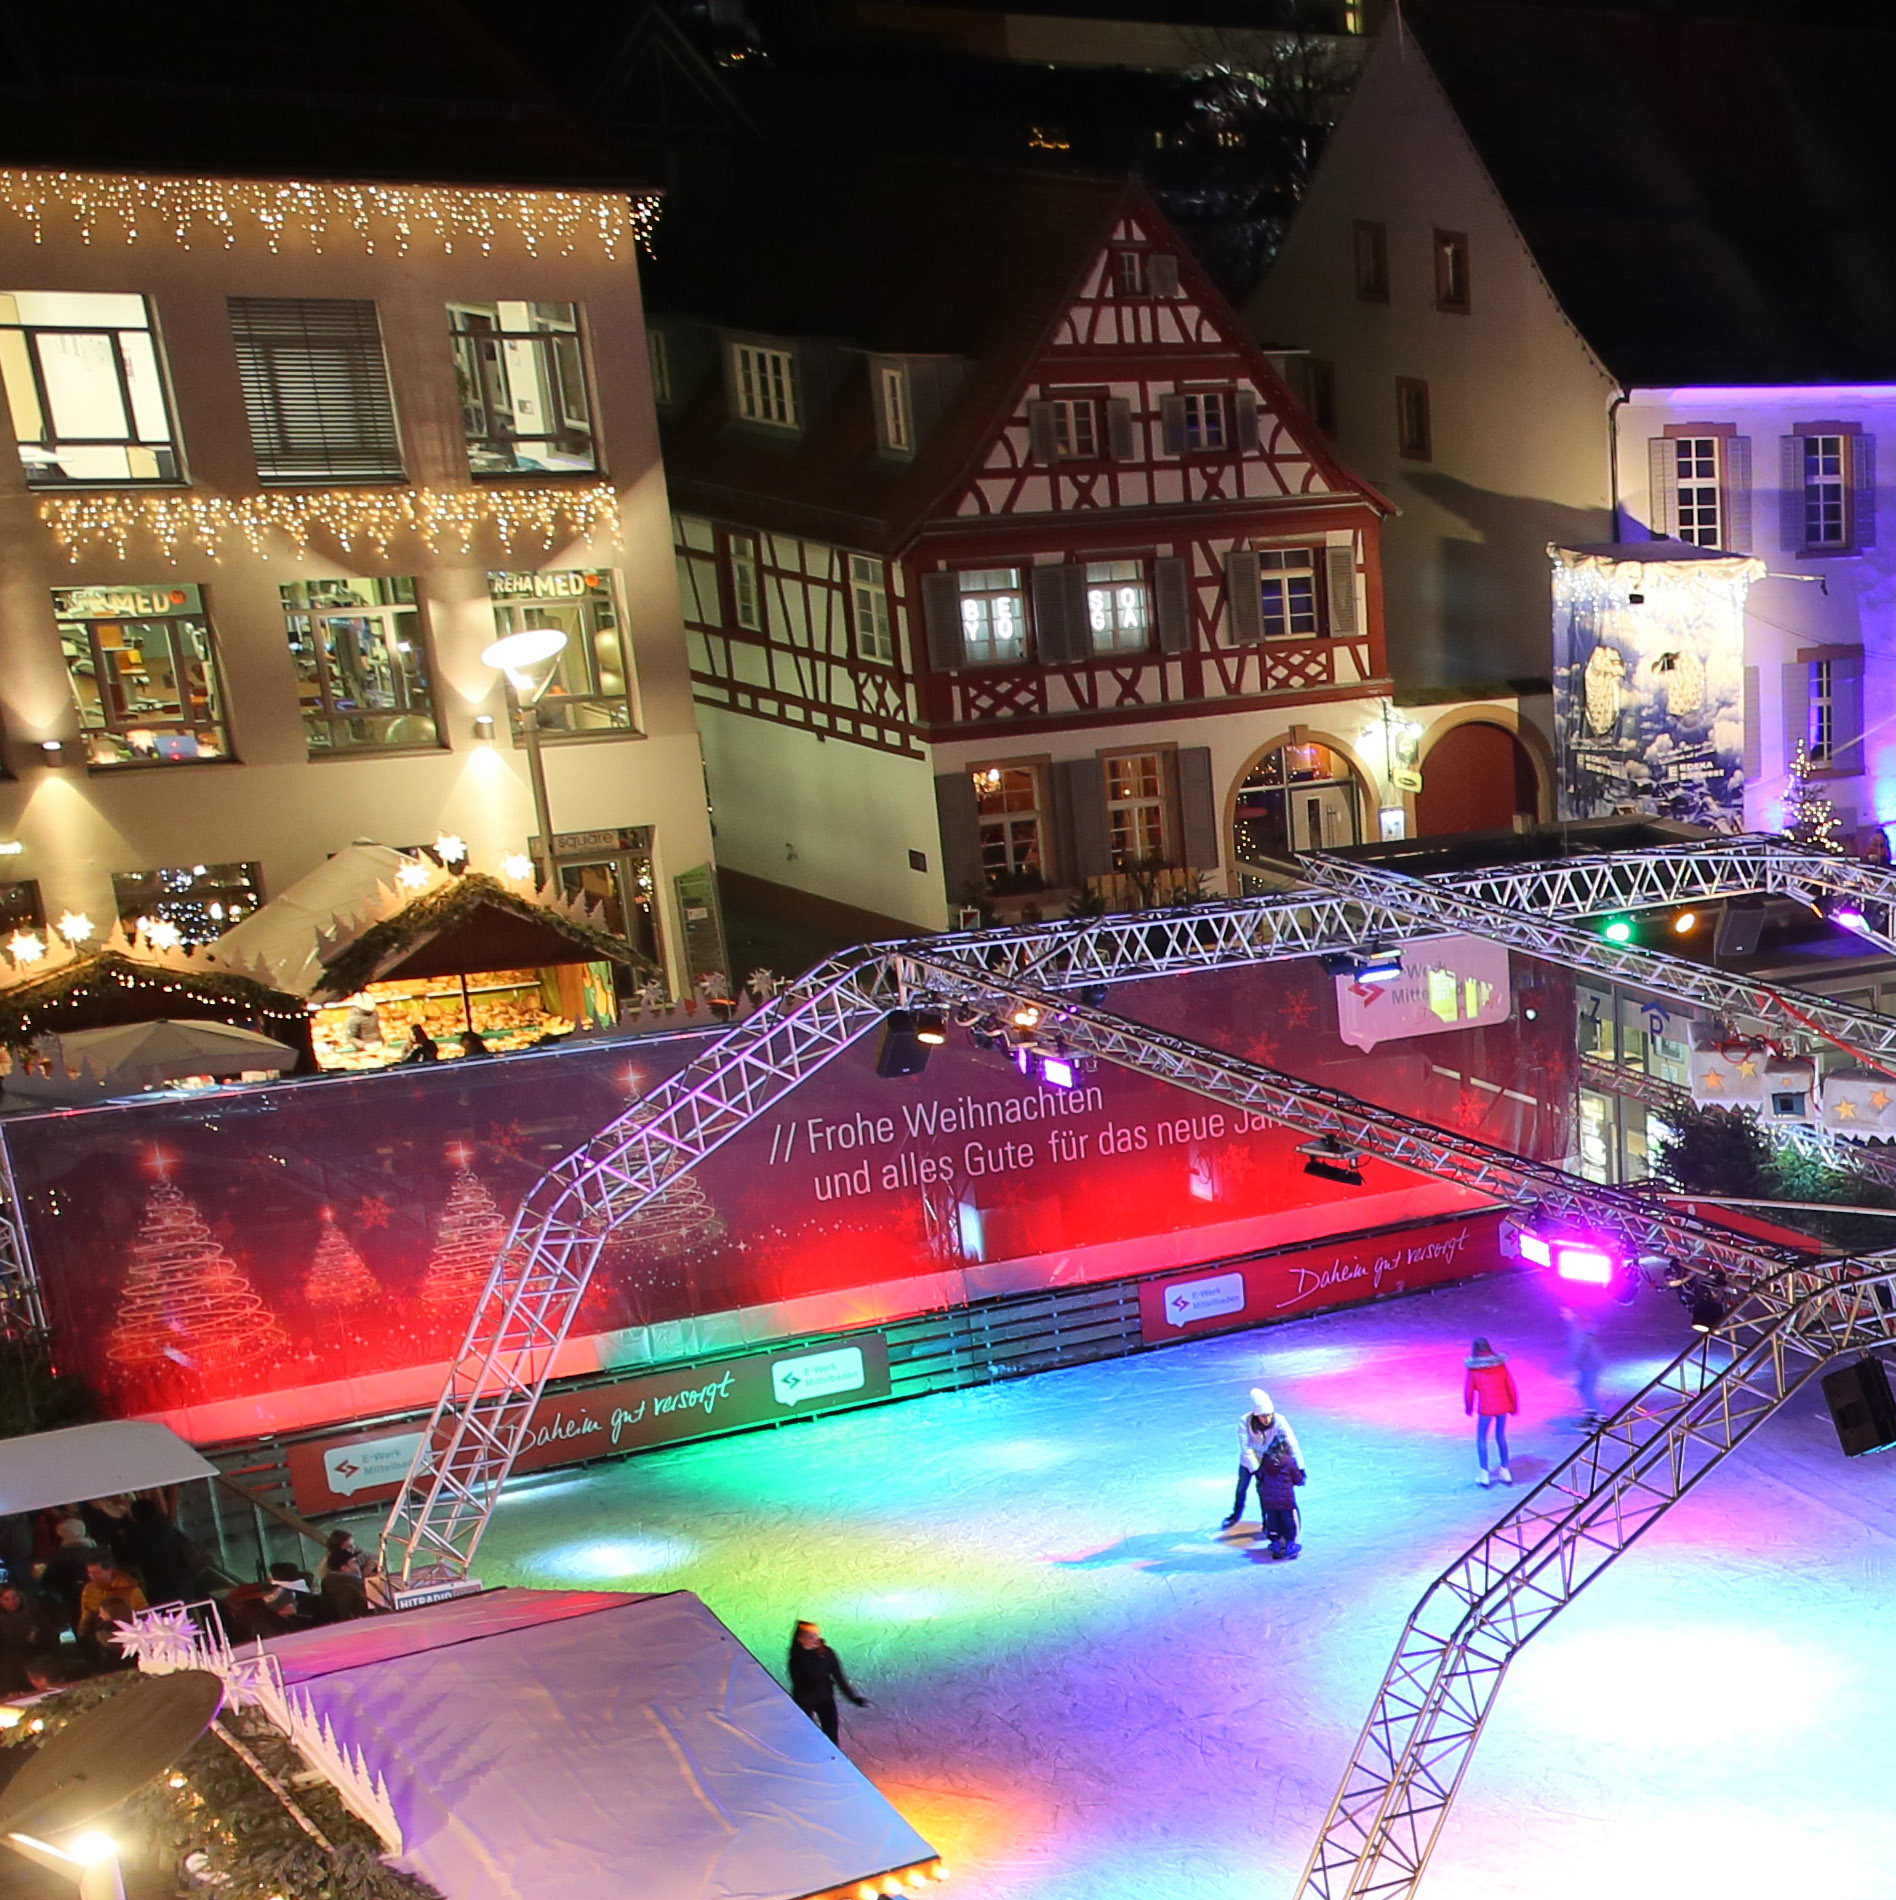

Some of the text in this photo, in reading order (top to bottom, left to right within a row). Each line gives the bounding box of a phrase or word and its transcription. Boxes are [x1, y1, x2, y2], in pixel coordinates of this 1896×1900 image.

[559, 832, 613, 849] square
[807, 1111, 894, 1155] Frohe
[903, 1084, 1103, 1139] Weihnachten
[813, 1159, 870, 1202] und
[881, 1151, 954, 1192] alles
[964, 1139, 1034, 1178] Gute
[1048, 1127, 1088, 1164] für
[1099, 1119, 1148, 1156] das
[1157, 1112, 1225, 1145] neue
[1276, 1227, 1470, 1308] Daheim gut versorgt
[611, 1402, 646, 1444] gut
[653, 1371, 736, 1415] versorgt
